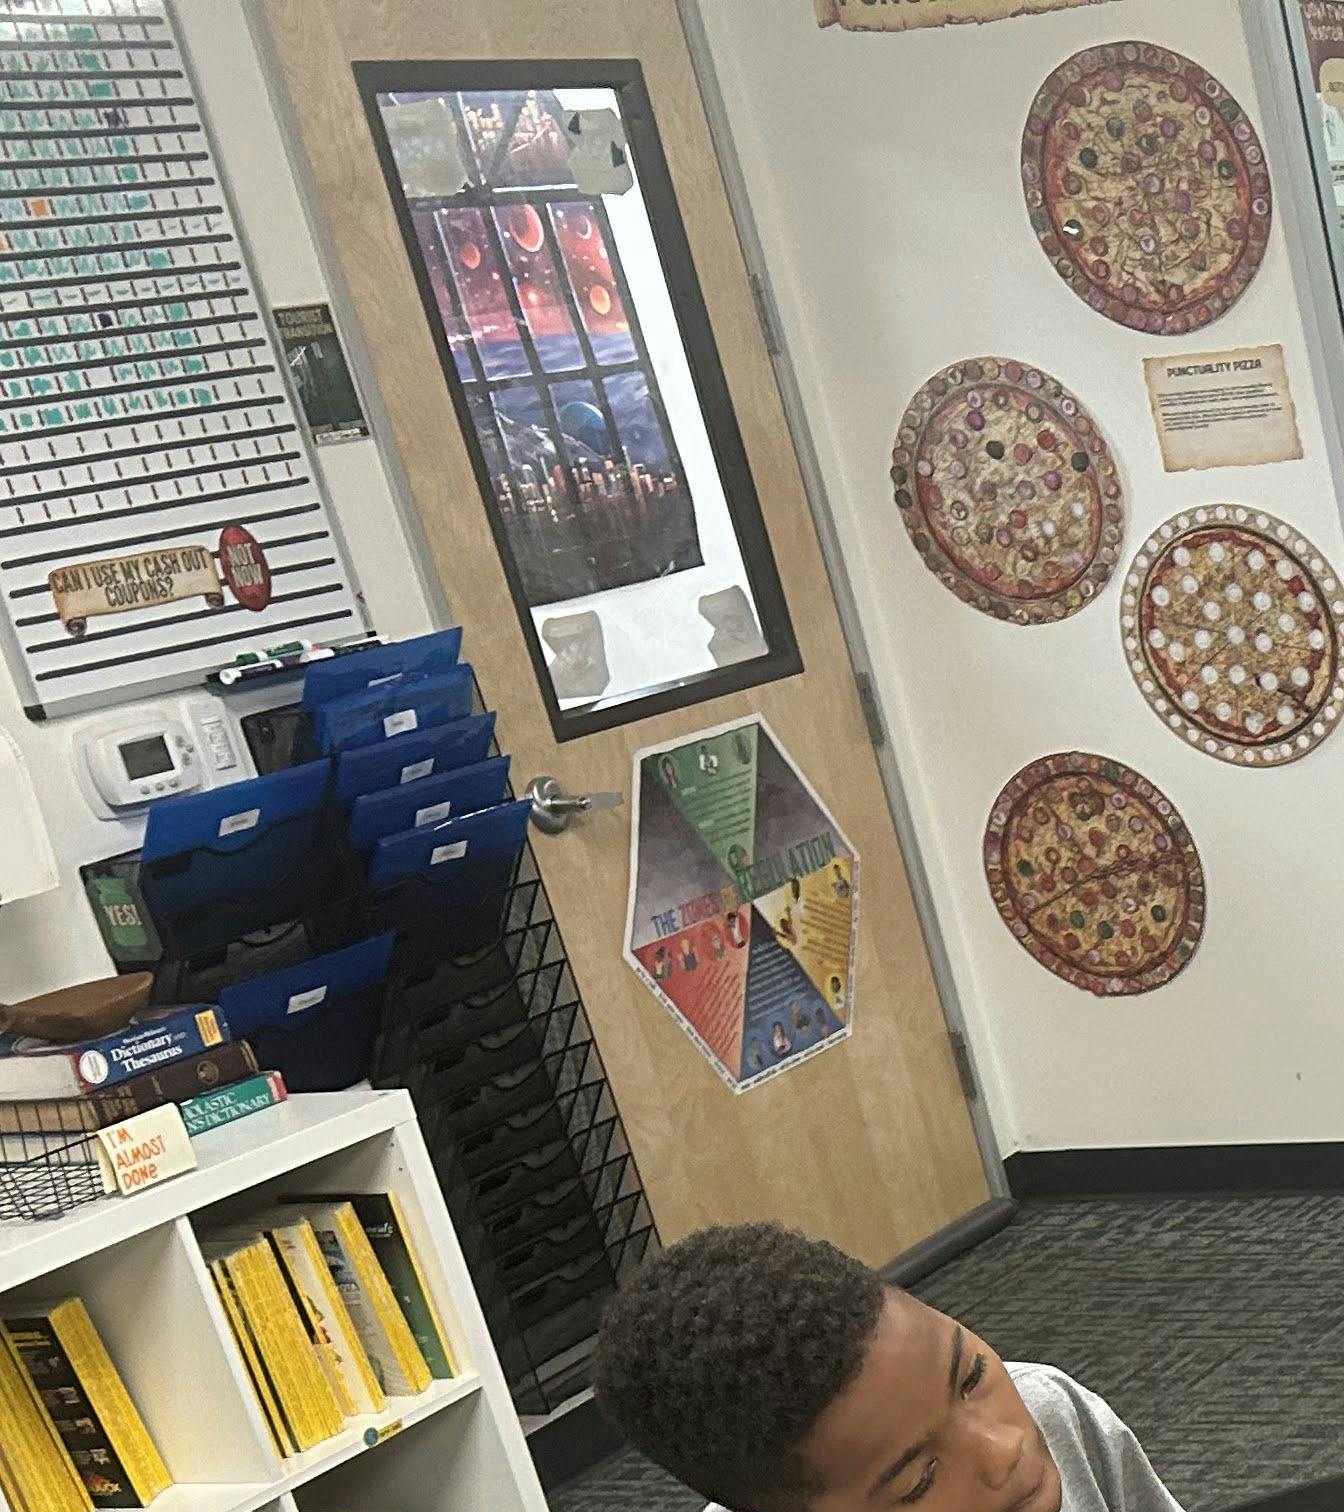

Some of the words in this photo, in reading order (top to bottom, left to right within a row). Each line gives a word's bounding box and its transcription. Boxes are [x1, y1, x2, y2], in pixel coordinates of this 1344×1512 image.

[1167, 362, 1231, 377] PUNCTUALITY
[1233, 358, 1262, 372] PIZZA
[52, 573, 85, 593] CAN
[93, 565, 120, 588] USE
[120, 560, 144, 582] MY
[144, 555, 182, 578] CASH
[183, 550, 209, 571] OUT
[104, 578, 175, 608] COUPONS?
[103, 902, 143, 927] YES!
[650, 911, 681, 939] THE
[110, 1031, 174, 1063] Dictionary
[120, 1046, 183, 1074] Thesaurus
[105, 1126, 135, 1150] I'M
[115, 1134, 168, 1167] ALMOST
